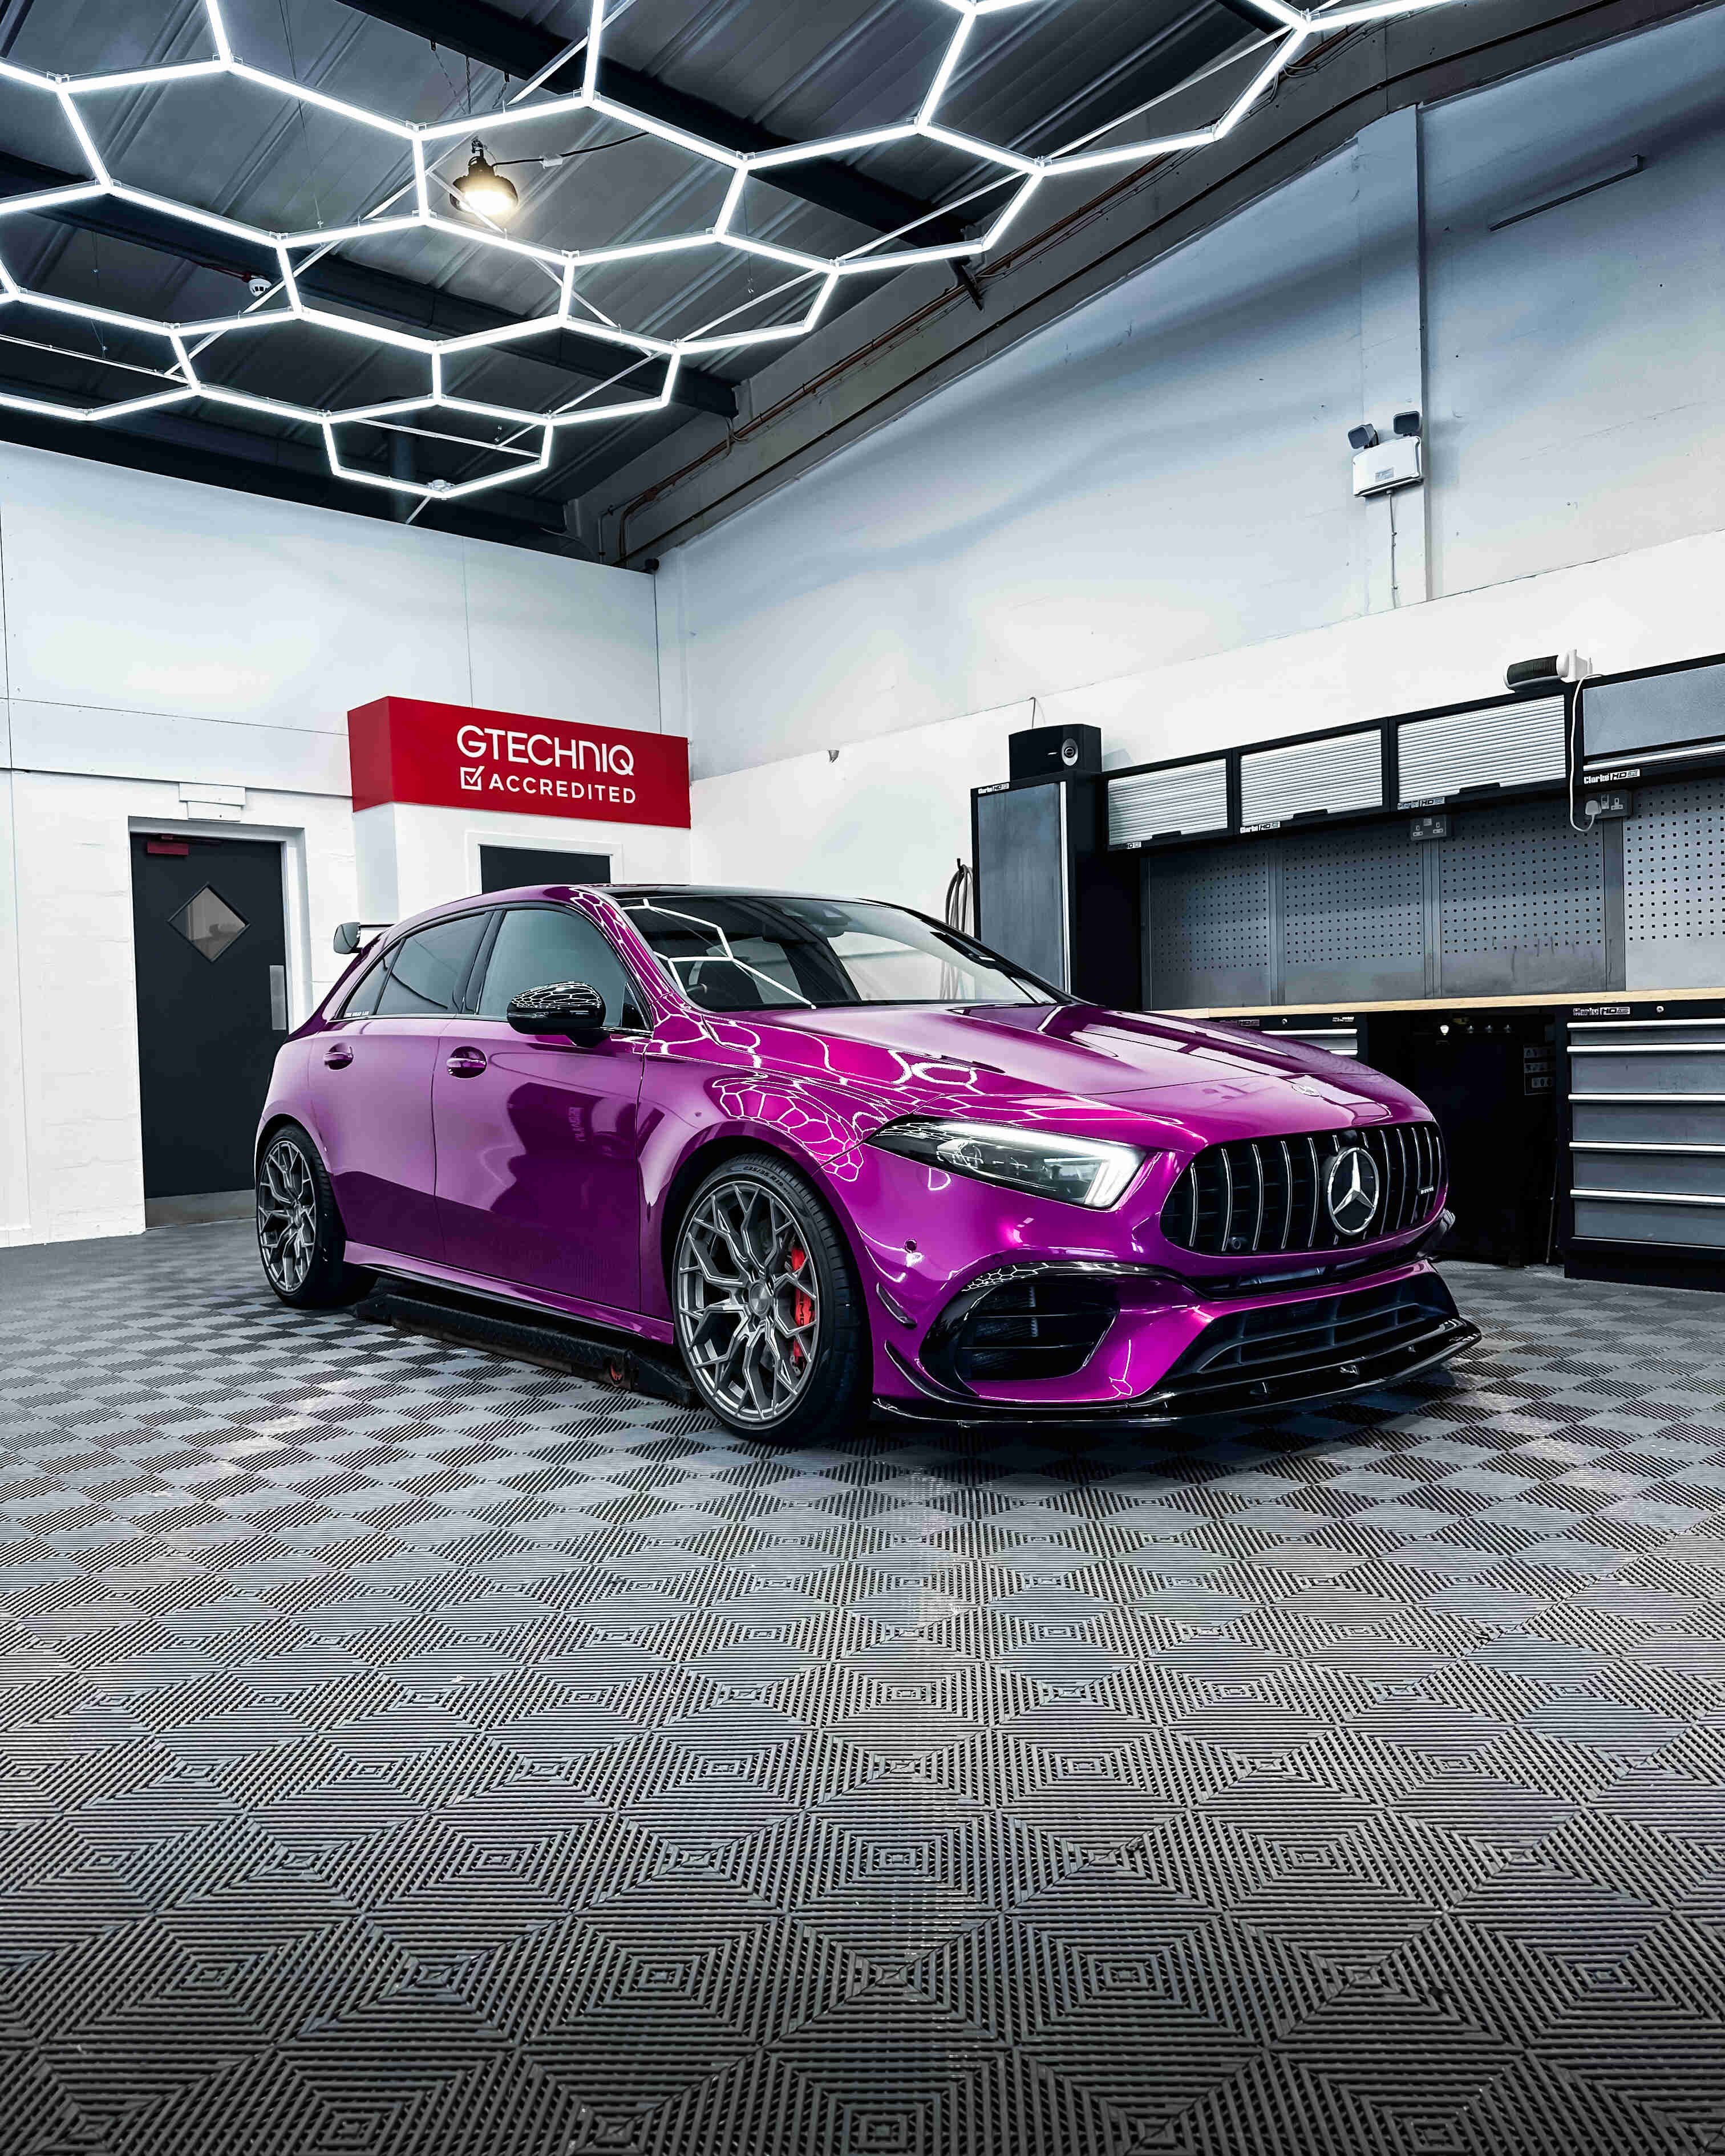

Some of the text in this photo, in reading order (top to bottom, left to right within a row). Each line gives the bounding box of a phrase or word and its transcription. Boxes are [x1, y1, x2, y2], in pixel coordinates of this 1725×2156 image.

[456, 725, 634, 776] GTECHNIQ
[489, 773, 636, 803] ACCREDITED
[1584, 773, 1610, 784] Clarke
